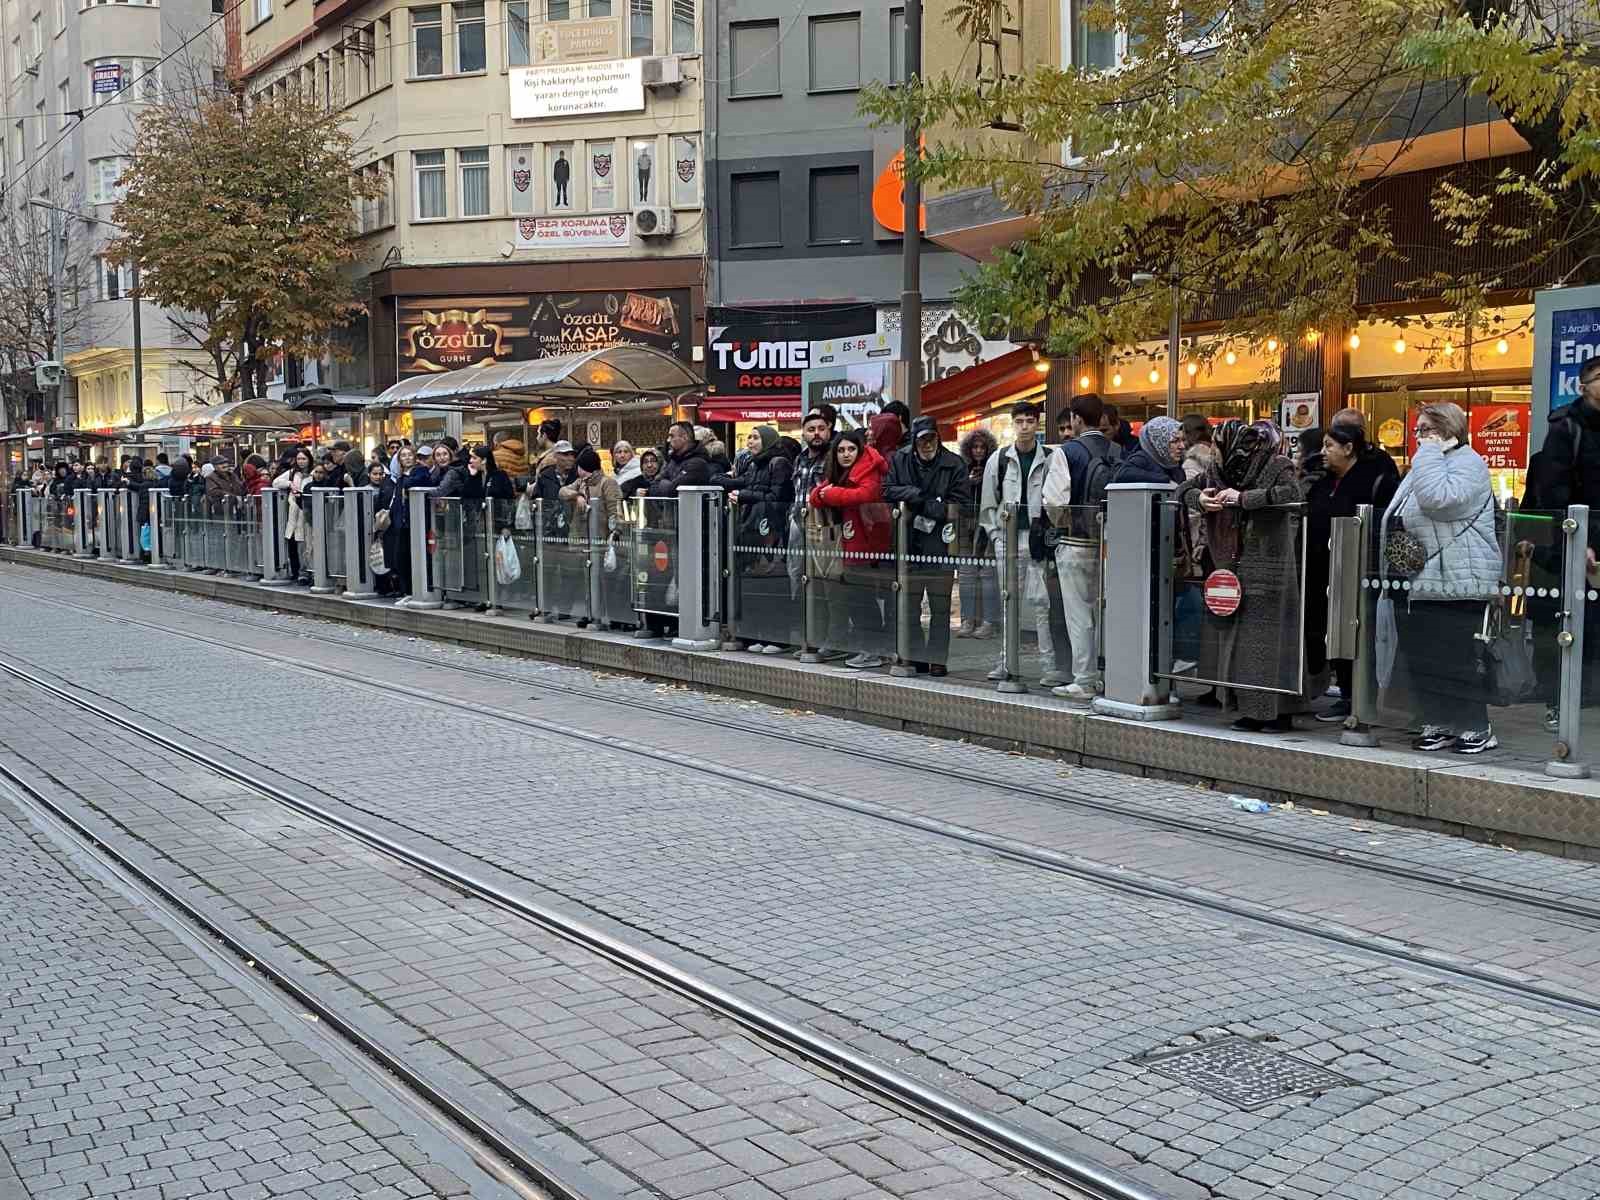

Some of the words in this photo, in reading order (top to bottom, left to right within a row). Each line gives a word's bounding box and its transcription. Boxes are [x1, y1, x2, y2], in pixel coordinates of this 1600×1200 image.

[524, 79, 539, 88] Kişi
[541, 75, 584, 86] haklarıyla
[586, 72, 630, 84] toplumun
[534, 92, 560, 102] yararı
[562, 89, 590, 99] denge
[591, 85, 618, 97] içinde
[547, 101, 606, 112] korunacaktır.
[560, 219, 608, 228] KORUMA
[537, 229, 560, 238] ÖZEL
[563, 312, 613, 326] ÖZGÜL
[419, 331, 492, 349] ÖZGÜL
[539, 335, 560, 343] DANA
[560, 326, 619, 343] KASAP
[440, 355, 472, 363] GURME
[822, 382, 872, 400] ANADOLU
